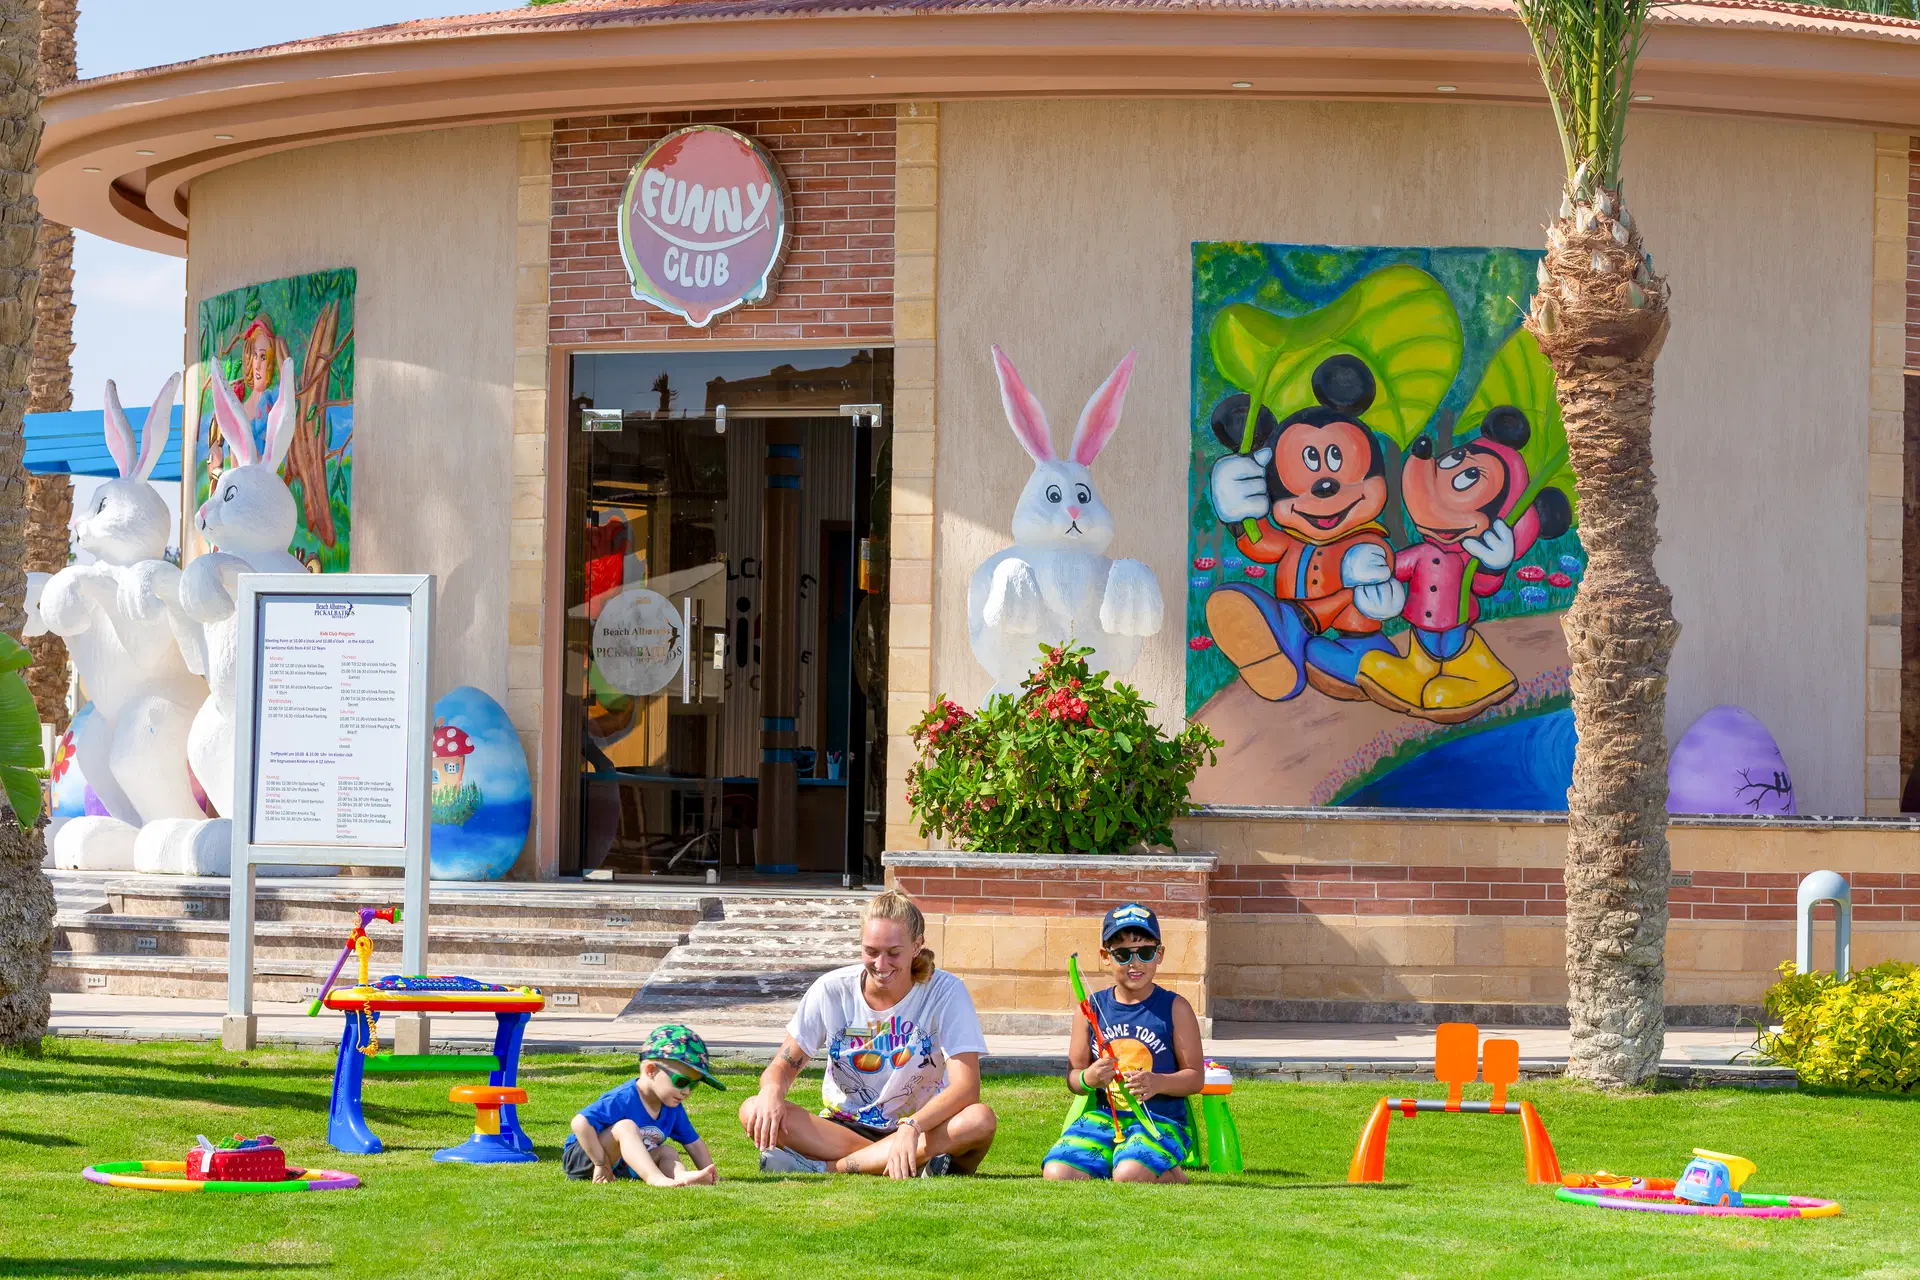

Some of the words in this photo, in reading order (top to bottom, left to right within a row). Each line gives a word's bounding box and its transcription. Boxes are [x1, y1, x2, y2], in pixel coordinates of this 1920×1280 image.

[642, 168, 771, 234] FUNNY
[664, 247, 729, 287] CLUB
[603, 628, 630, 636] Beach
[1135, 1025, 1166, 1054] TODAY
